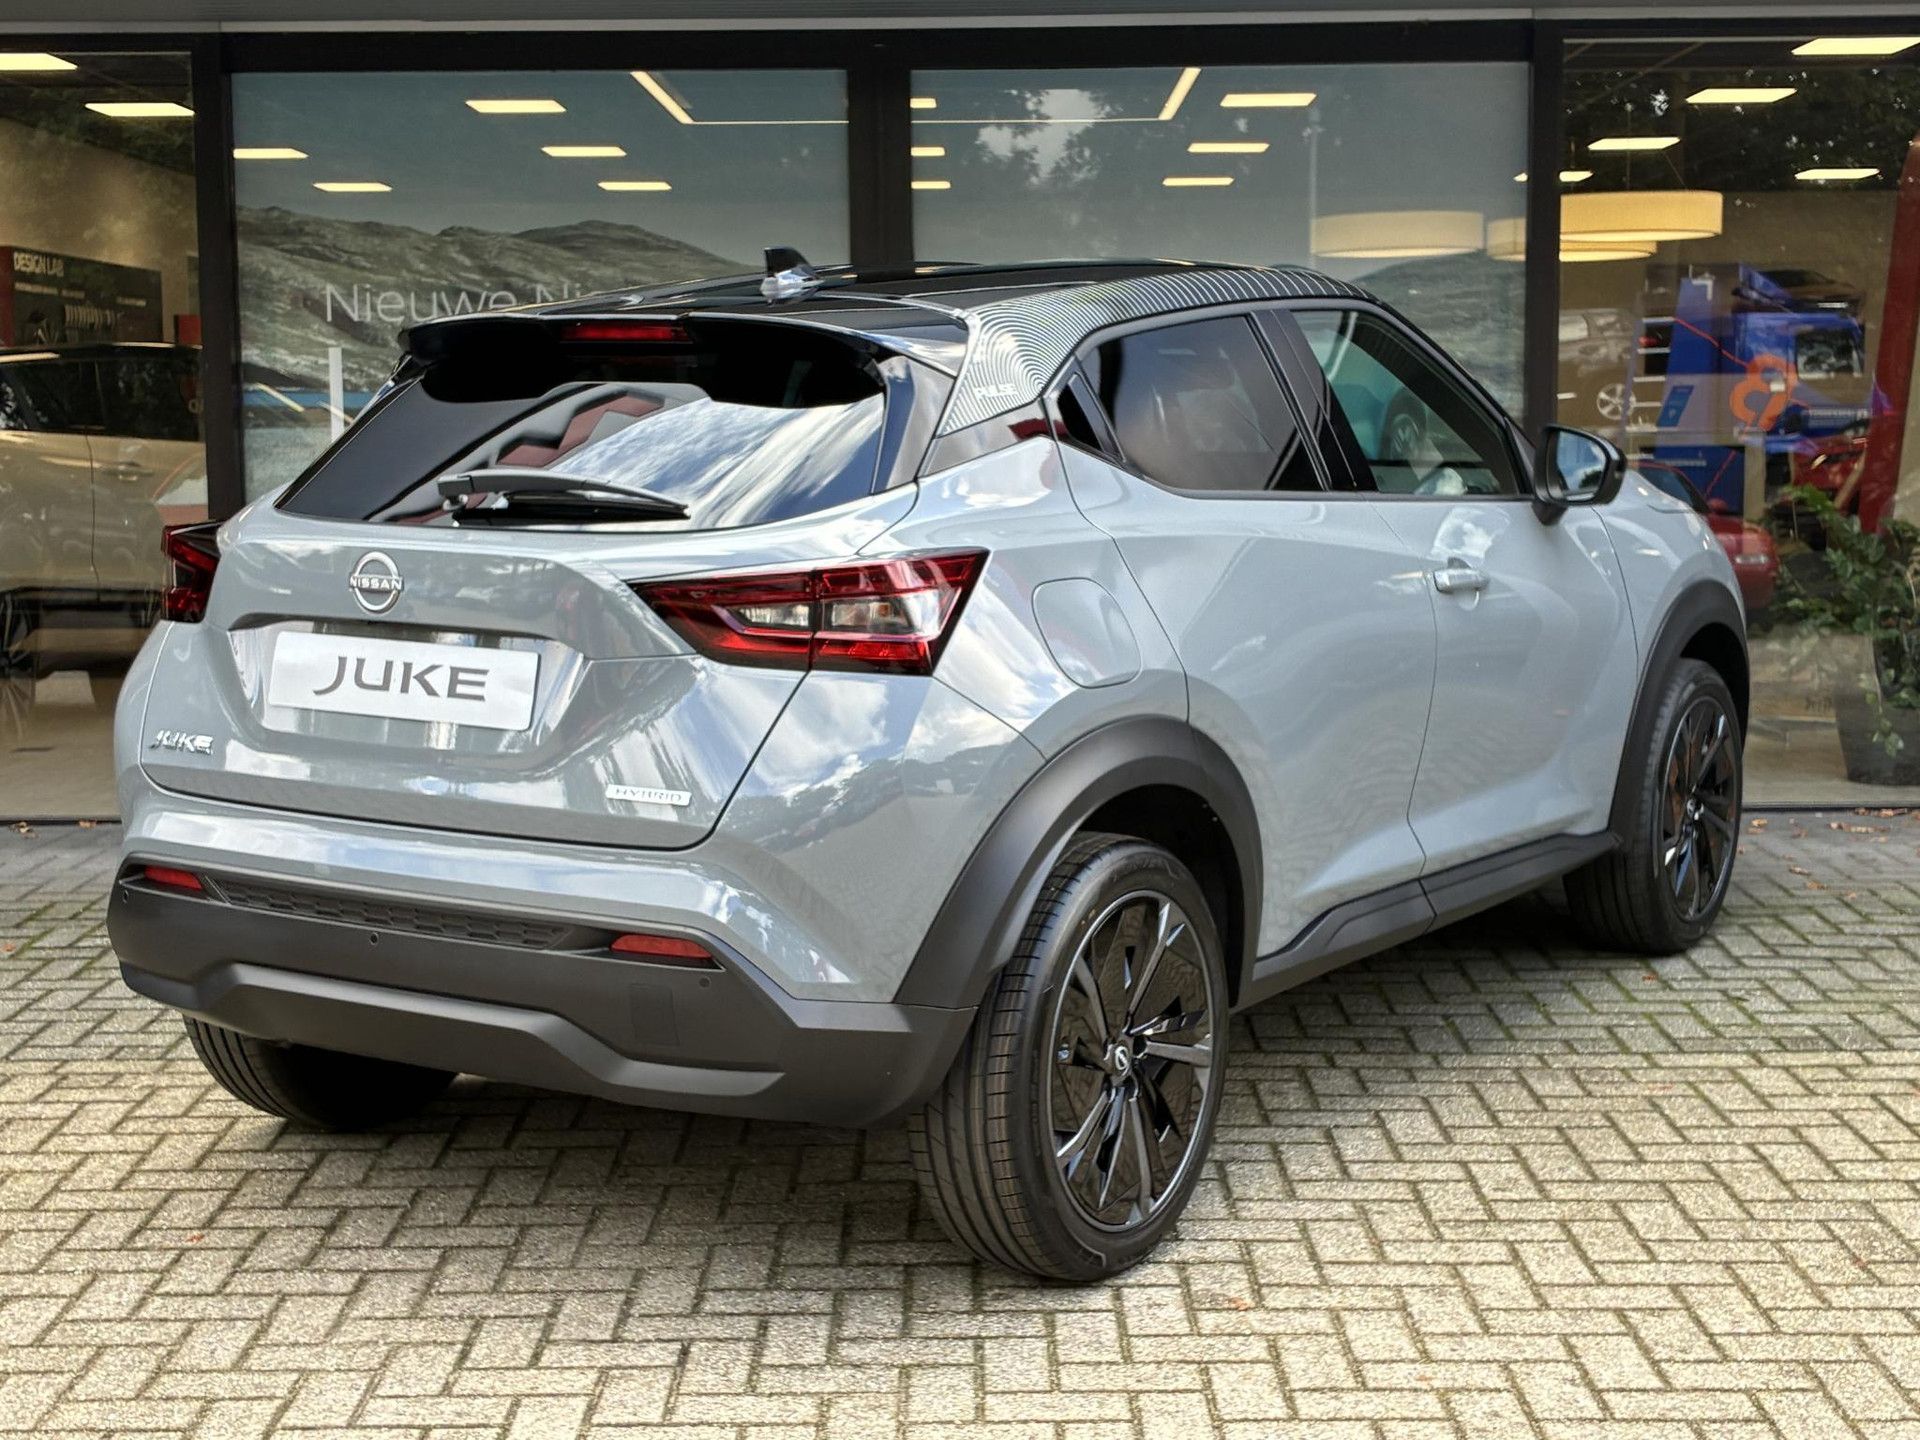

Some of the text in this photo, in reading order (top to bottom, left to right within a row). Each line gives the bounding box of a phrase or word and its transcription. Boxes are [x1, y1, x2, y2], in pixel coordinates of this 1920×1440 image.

[13, 251, 46, 274] DESIGN
[325, 283, 517, 322] Nieuwe
[349, 575, 403, 591] NISSAN
[312, 655, 490, 701] JUKE
[149, 729, 215, 756] JUKE
[614, 786, 682, 803] HYBRID
